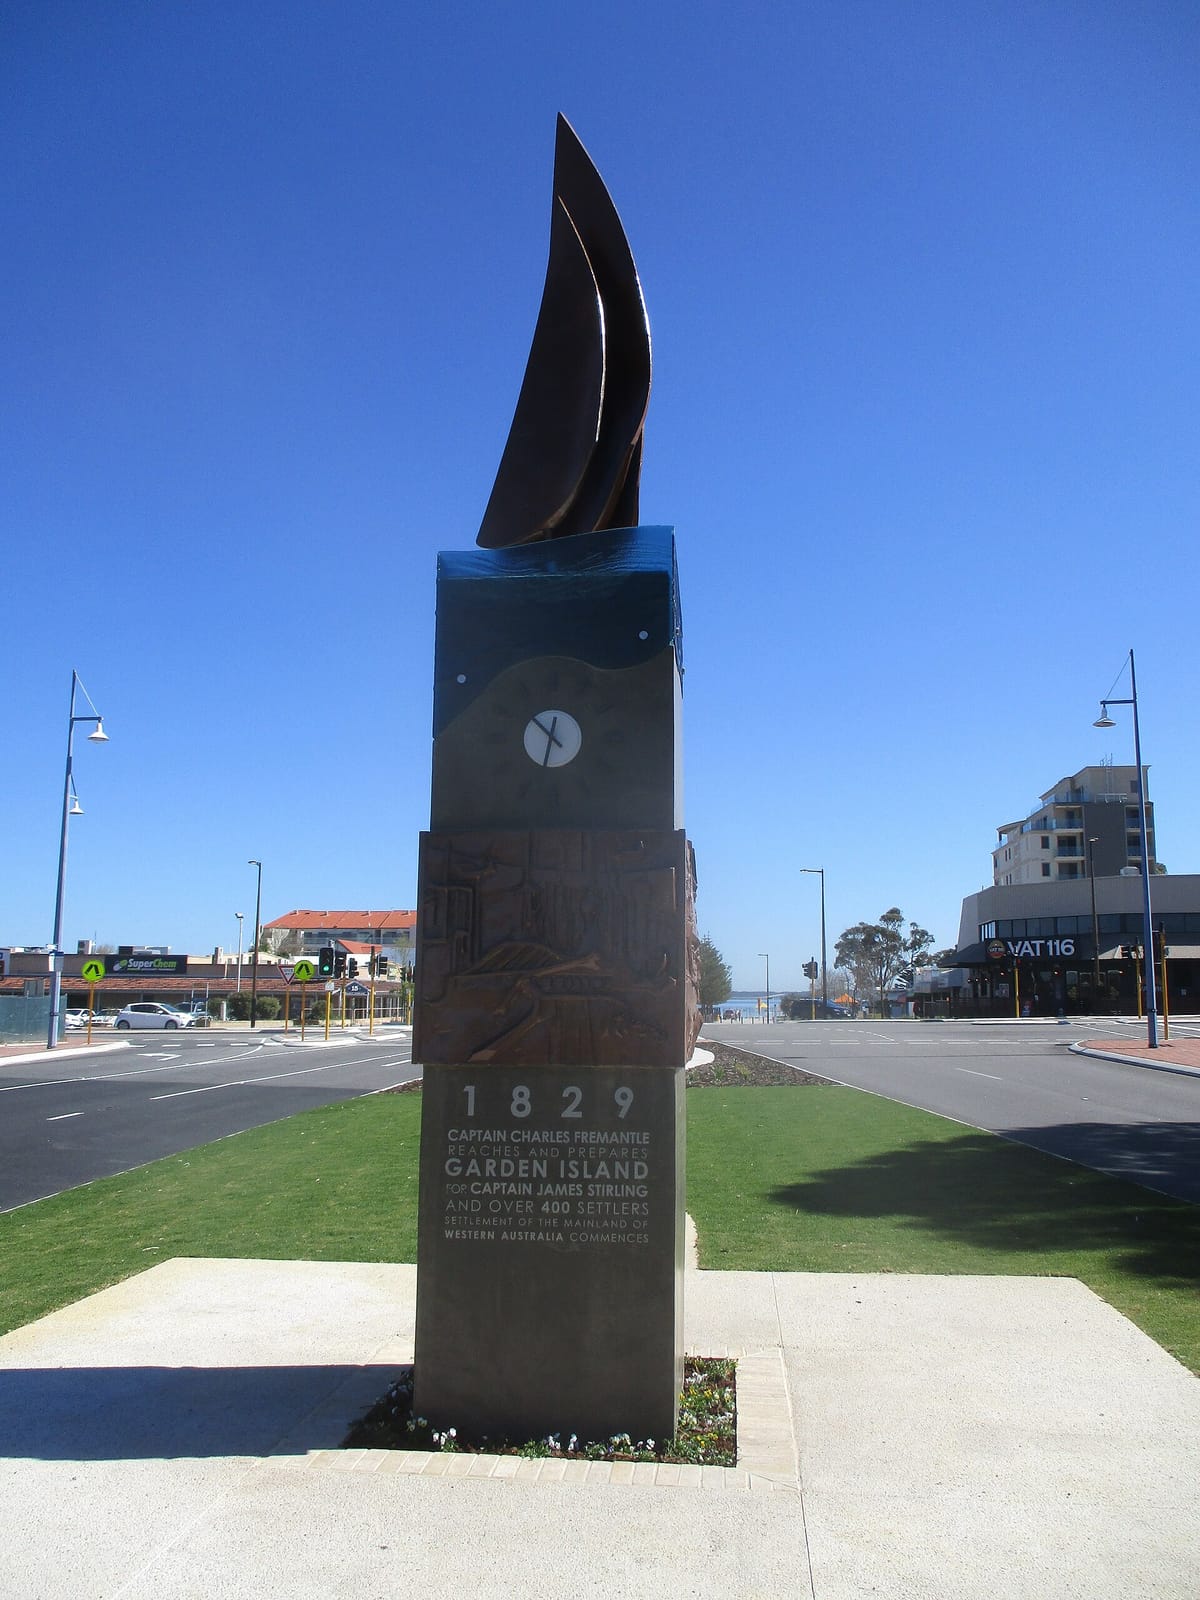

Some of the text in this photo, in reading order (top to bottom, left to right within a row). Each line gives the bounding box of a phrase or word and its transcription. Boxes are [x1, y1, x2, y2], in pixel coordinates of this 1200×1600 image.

[1007, 939, 1075, 957] VAT 116
[127, 958, 177, 969] SuperChem
[447, 1129, 650, 1144] CAPTAIN CHARLES FREMANTLE
[448, 1144, 648, 1159] REACHES AND PREPARES
[445, 1158, 649, 1179] GARDEN ISLAND
[446, 1182, 648, 1197] FOR CAPTAIN JAMES STIRLING
[445, 1200, 649, 1215] AND OVER 400 SETTLERS
[444, 1216, 648, 1229] SETTLEMENT OF THE MAINLAND OF
[444, 1230, 649, 1243] WESTERN AUSTRALIA COMMENCES
